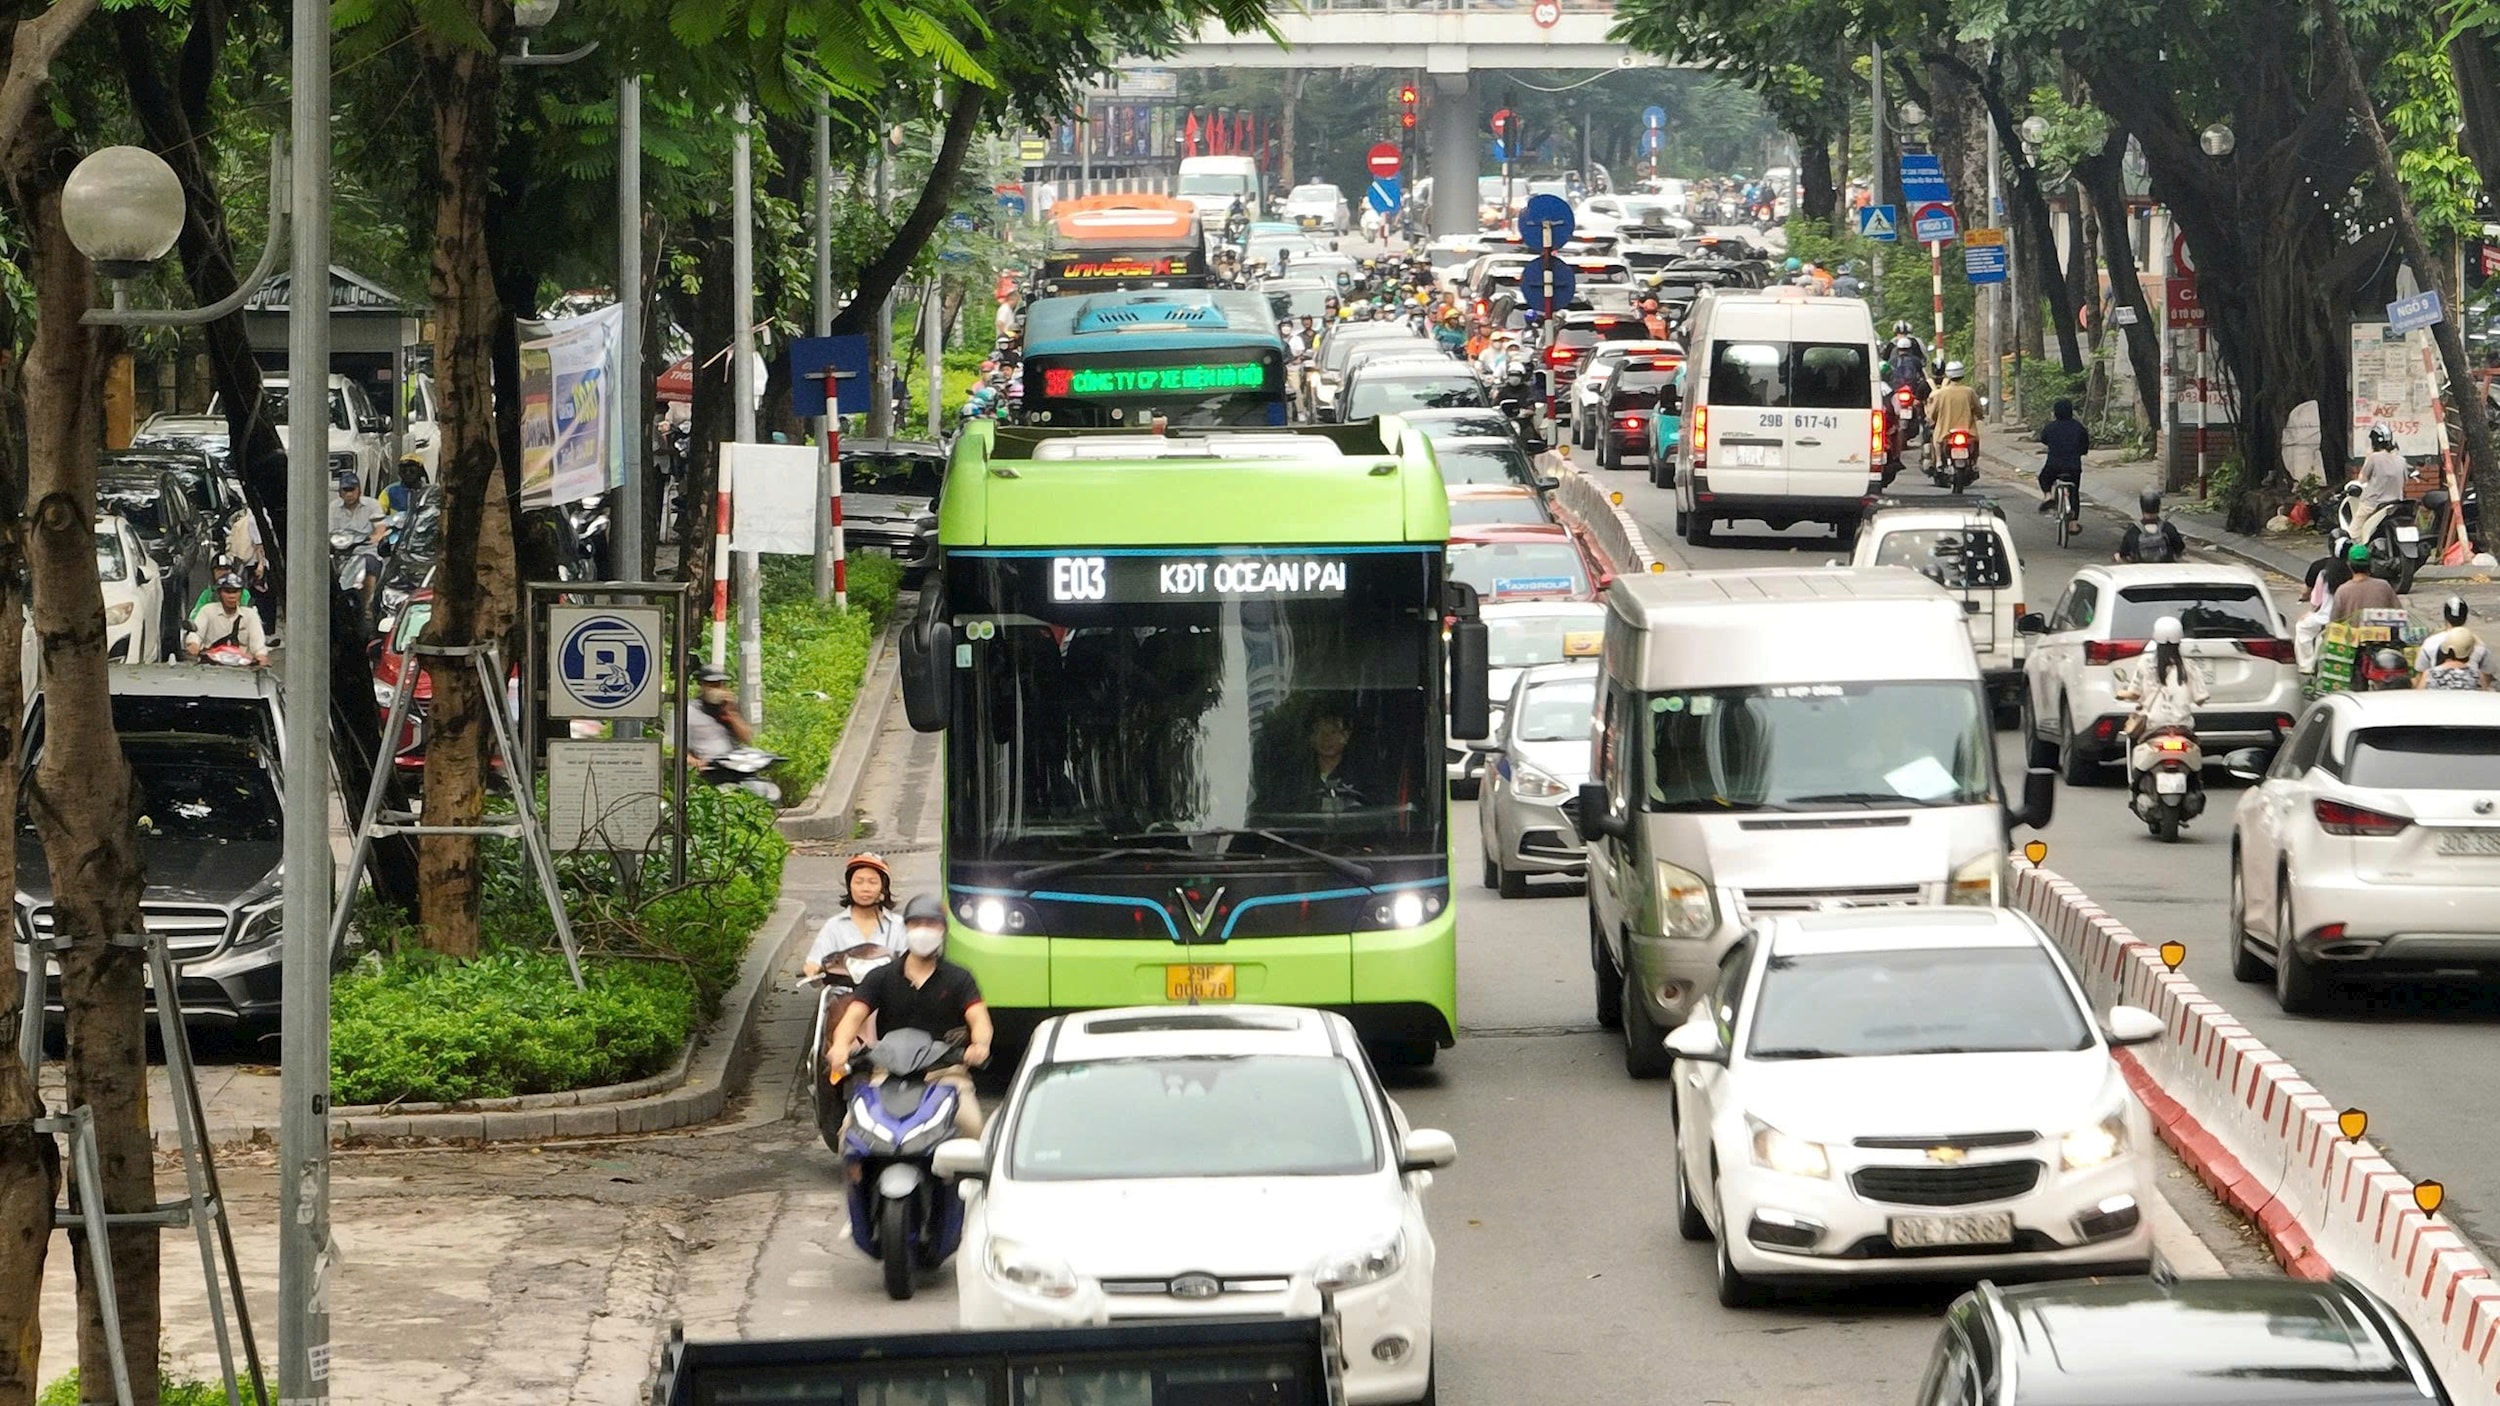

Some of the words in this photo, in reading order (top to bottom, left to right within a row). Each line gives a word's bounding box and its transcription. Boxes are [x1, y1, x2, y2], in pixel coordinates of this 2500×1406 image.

[2421, 299, 2429, 310] 9
[1115, 371, 1136, 390] TY
[1160, 370, 1181, 388] XE
[1759, 414, 1783, 427] 29B
[1794, 415, 1838, 429] 617-41
[1053, 557, 1105, 600] E03
[1160, 563, 1208, 593] KĐT
[1213, 562, 1299, 593] OCEAN
